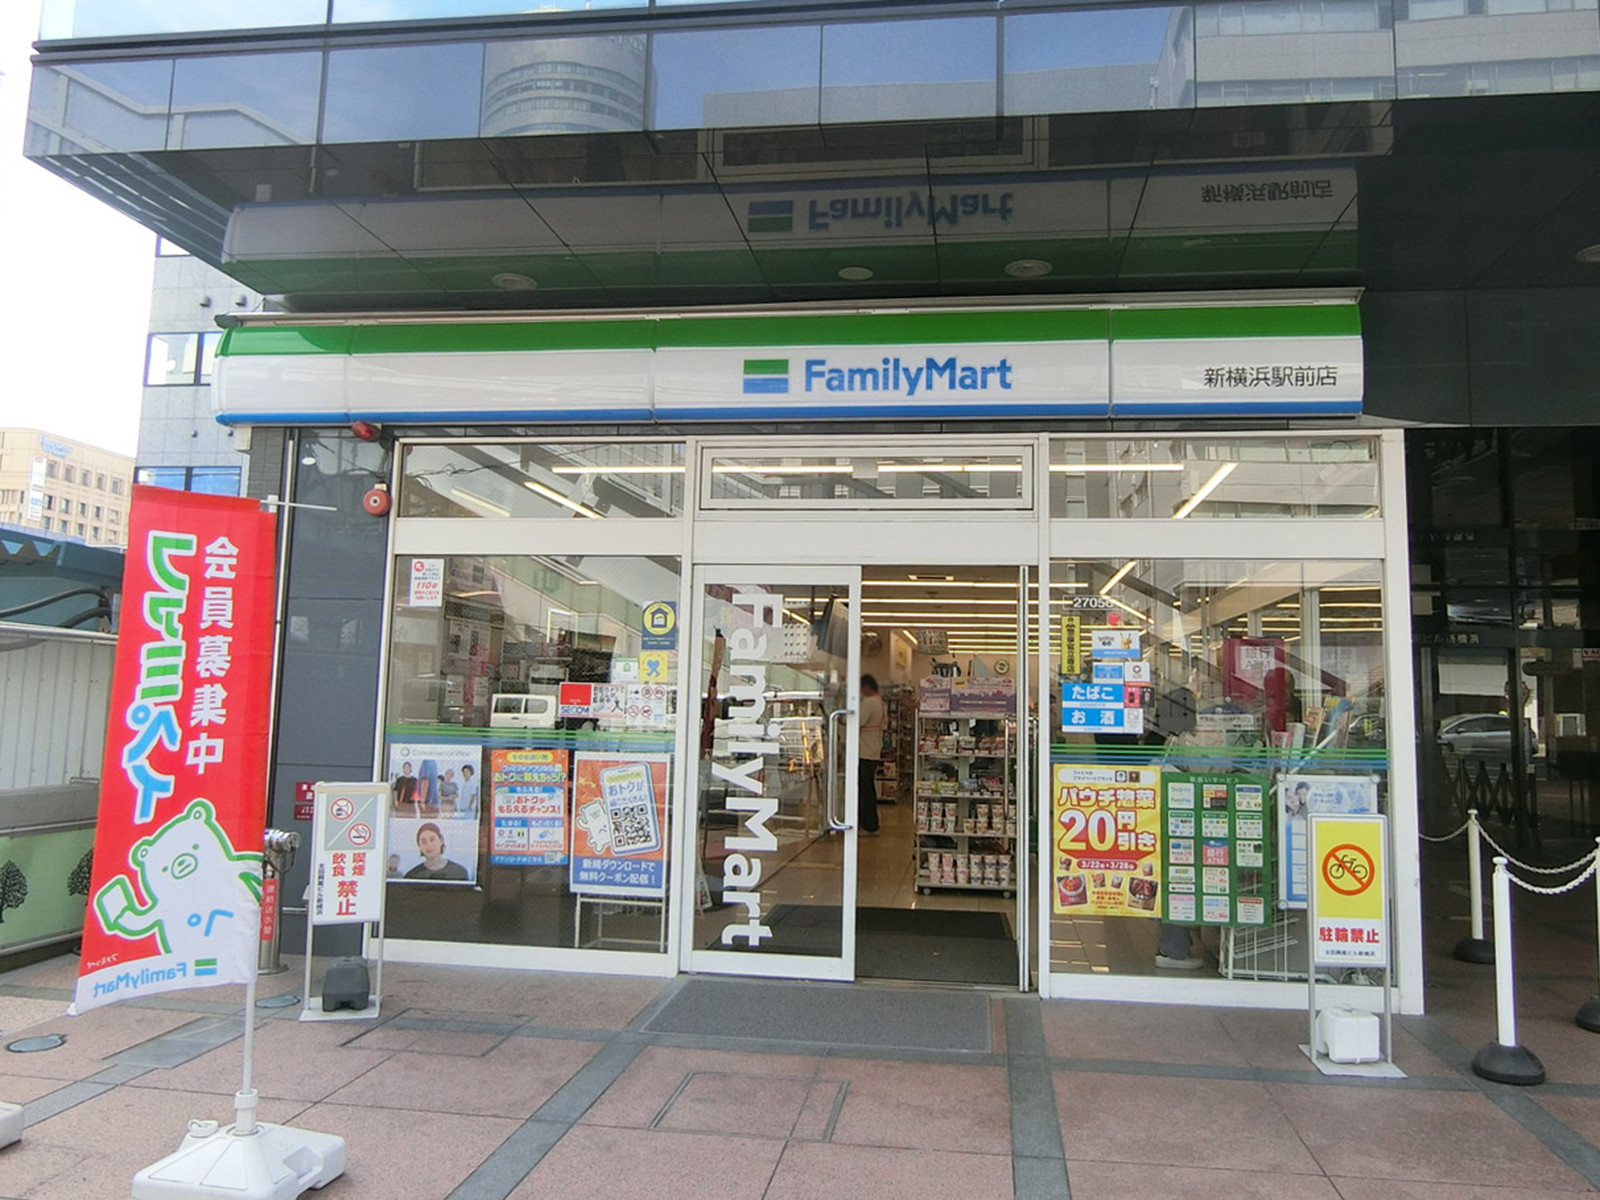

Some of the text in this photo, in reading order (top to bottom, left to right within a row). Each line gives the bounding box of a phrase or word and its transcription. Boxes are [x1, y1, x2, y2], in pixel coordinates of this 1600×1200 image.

[804, 356, 1012, 396] FamilyMart
[1203, 364, 1338, 388] 新横浜駅前店
[1071, 685, 1115, 700] たばこ
[560, 705, 590, 715] SECOM
[1071, 710, 1115, 725] お酒
[711, 593, 784, 946] FamilyMart
[1058, 786, 1156, 809] パウチ惣菜
[1058, 808, 1116, 851] 20
[332, 853, 346, 877] 飲食
[336, 880, 358, 916] 禁止
[1319, 926, 1380, 944] 駐輪禁止
